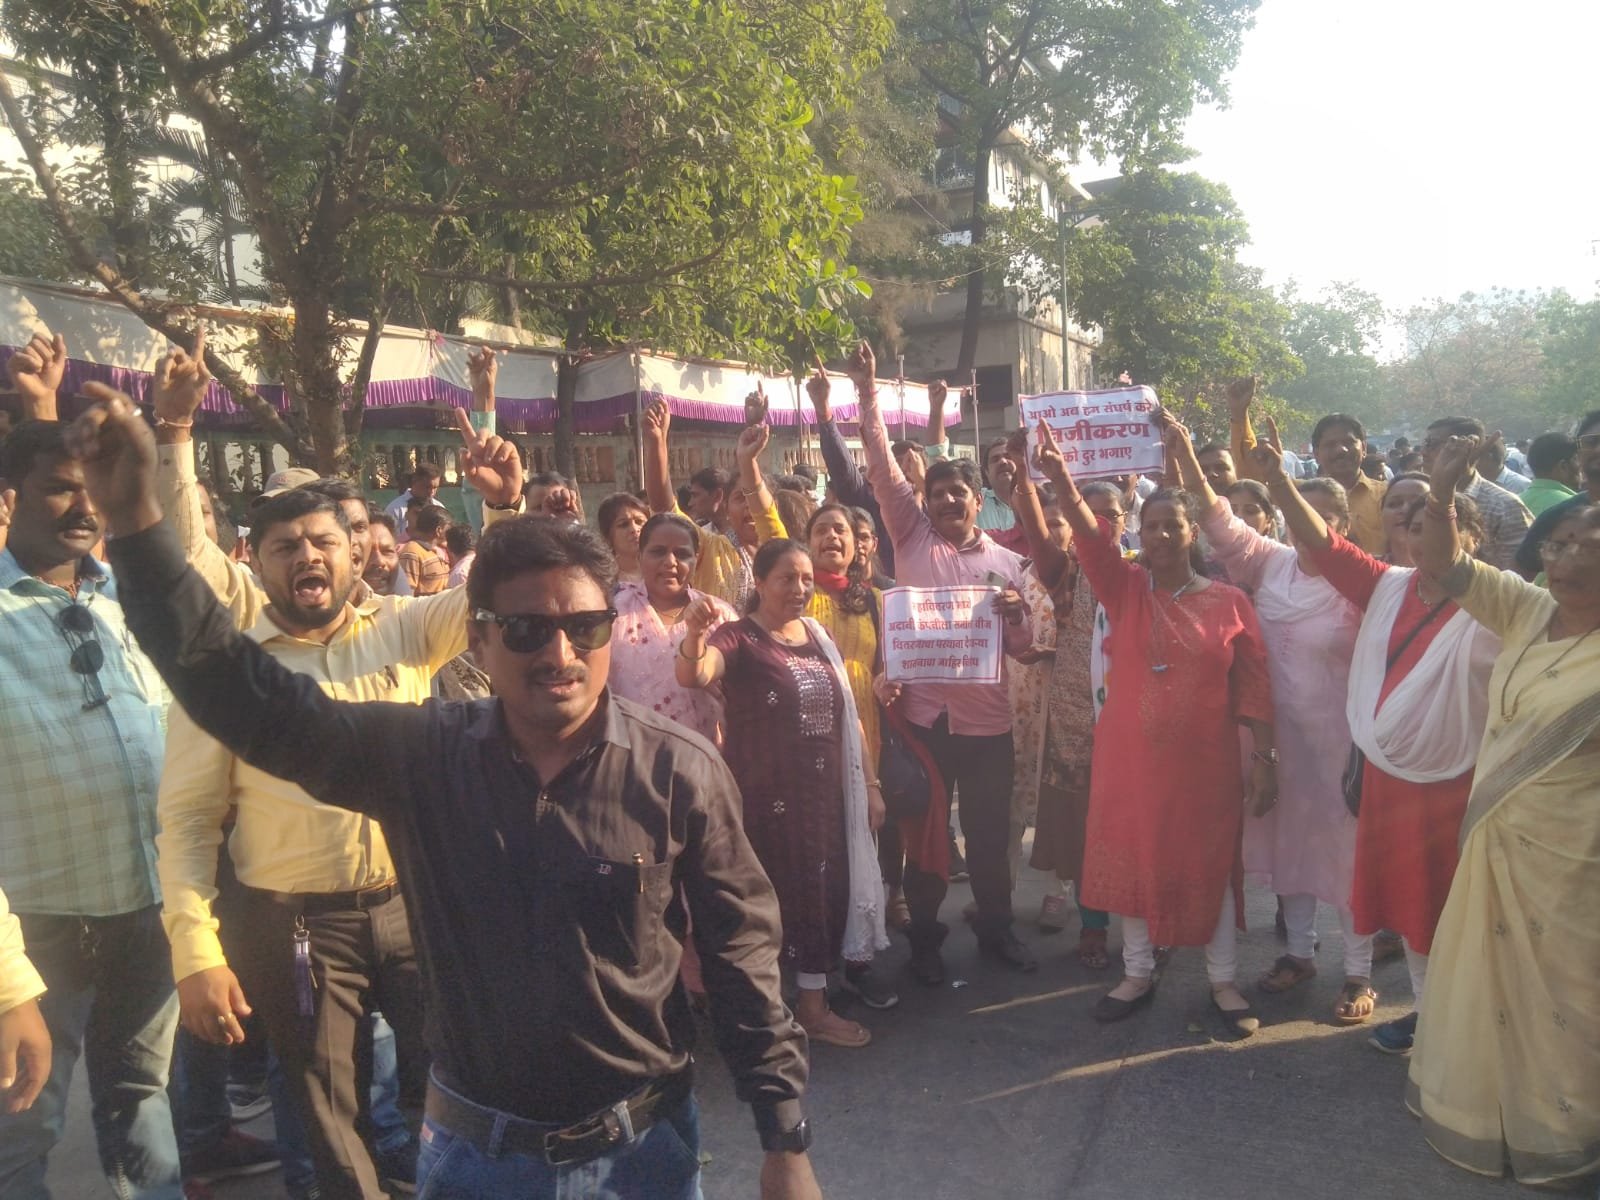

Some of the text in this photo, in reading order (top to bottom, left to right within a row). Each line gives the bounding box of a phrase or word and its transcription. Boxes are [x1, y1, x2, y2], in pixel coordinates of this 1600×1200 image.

[1028, 405, 1056, 420] आओ
[1060, 406, 1079, 417] अब
[1082, 405, 1100, 416] हम
[1104, 399, 1132, 413] संघर्ष
[1036, 419, 1151, 445] निजीकरण
[1082, 449, 1096, 466] दुर
[1098, 446, 1133, 460] भगाए
[888, 617, 915, 631] अदानी
[918, 617, 952, 631] कंपनीला
